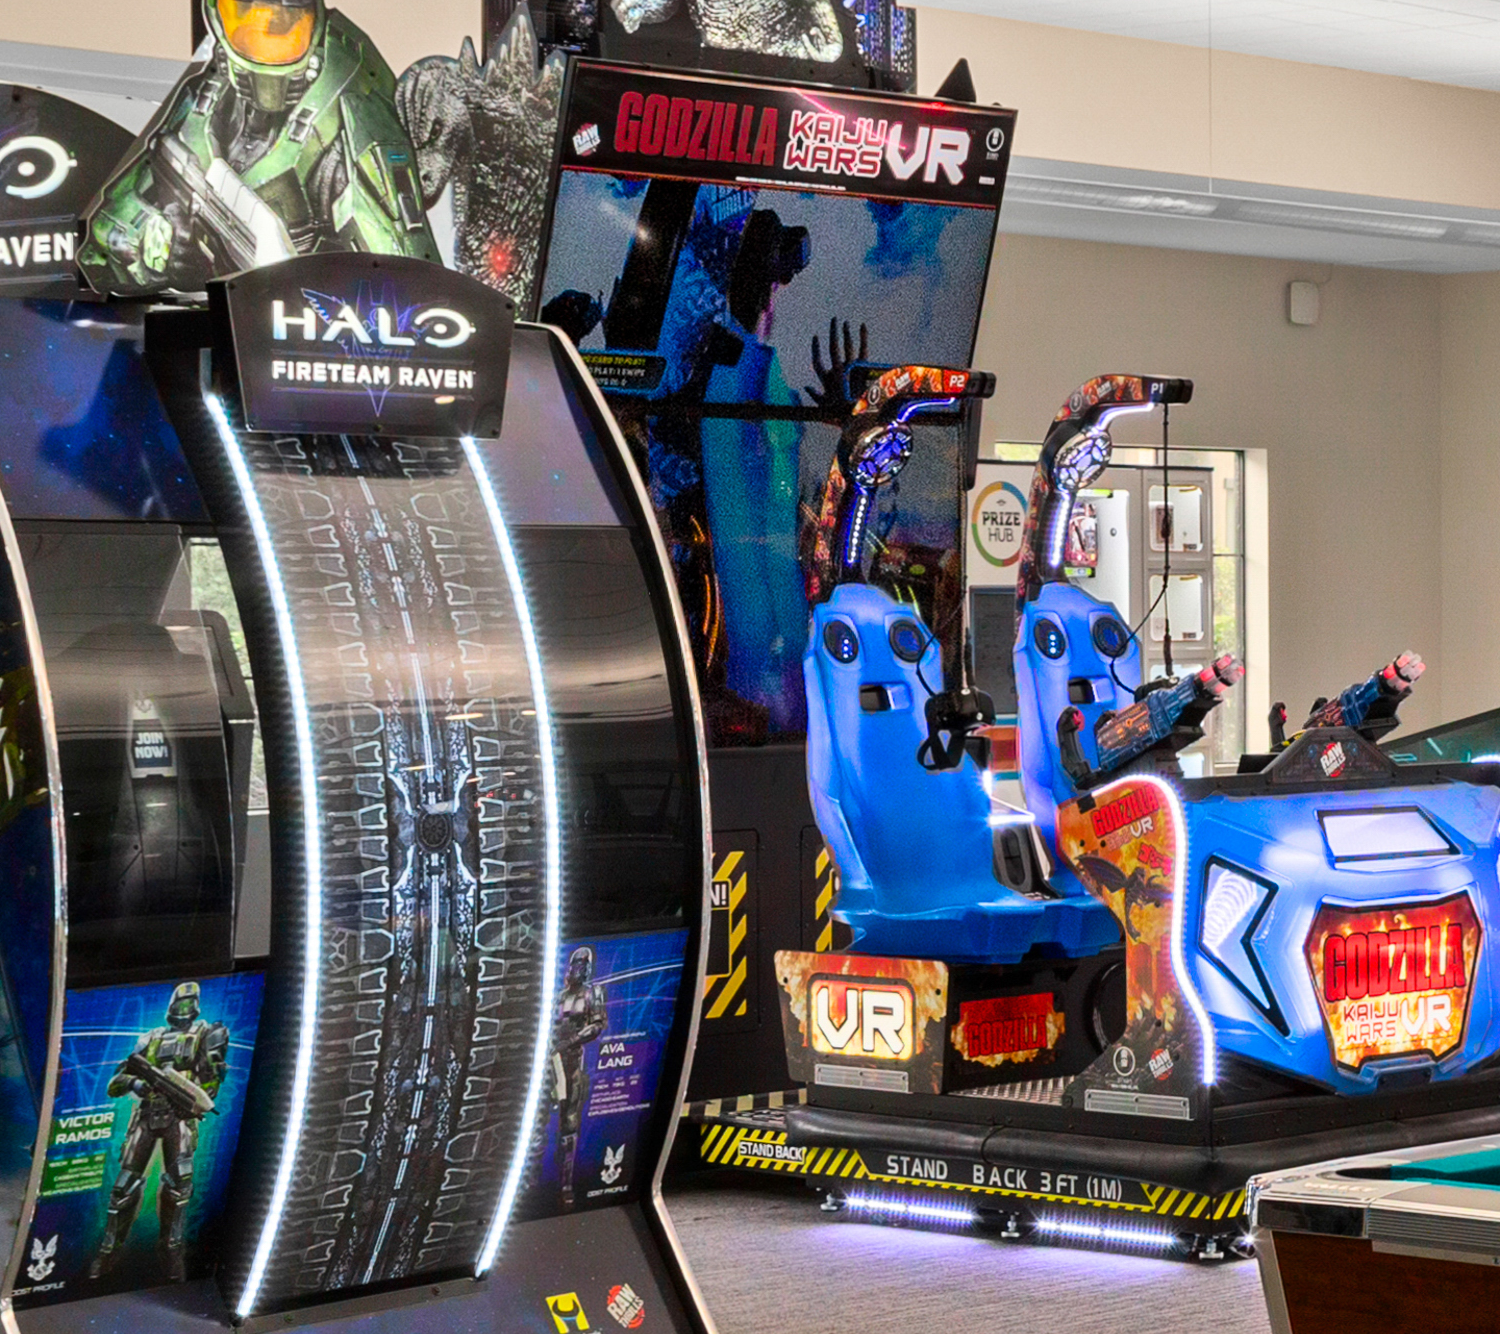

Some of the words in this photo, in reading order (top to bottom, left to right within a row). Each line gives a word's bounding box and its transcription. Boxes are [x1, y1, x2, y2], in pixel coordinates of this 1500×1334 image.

[614, 91, 778, 166] GODZILLA
[789, 110, 888, 147] KAIJU
[784, 140, 883, 178] WARS
[886, 122, 971, 185] VR
[273, 300, 475, 348] HALO
[273, 360, 390, 386] FIRETEAM
[399, 367, 474, 388] RAVEN
[950, 375, 965, 387] P2
[1151, 383, 1164, 394] P1
[982, 511, 1021, 526] PRIZE
[988, 527, 1014, 542] HUB
[135, 732, 164, 745] JOIN
[134, 745, 168, 759] NOW!
[1320, 742, 1344, 767] RAW
[1090, 785, 1160, 838] GODZILLA
[1129, 816, 1154, 838] VR
[1323, 923, 1466, 1003] GODZILLA
[817, 986, 905, 1054] VR
[1344, 1000, 1399, 1022] KAIJU
[1400, 994, 1452, 1036] VR
[966, 1014, 1049, 1058] GODZILLA
[1347, 1021, 1396, 1043] WARS
[600, 1043, 626, 1055] AVA
[1149, 1049, 1172, 1069] RAW
[598, 1055, 634, 1069] LANG
[59, 1112, 115, 1128] VICTOR
[55, 1128, 112, 1144] RAMOS
[739, 1142, 773, 1158] STAND
[775, 1146, 803, 1162] BACK
[887, 1156, 948, 1178] STAND
[973, 1166, 1027, 1190] BACK
[1086, 1177, 1123, 1202] (1M)
[607, 1283, 636, 1321] RAW
